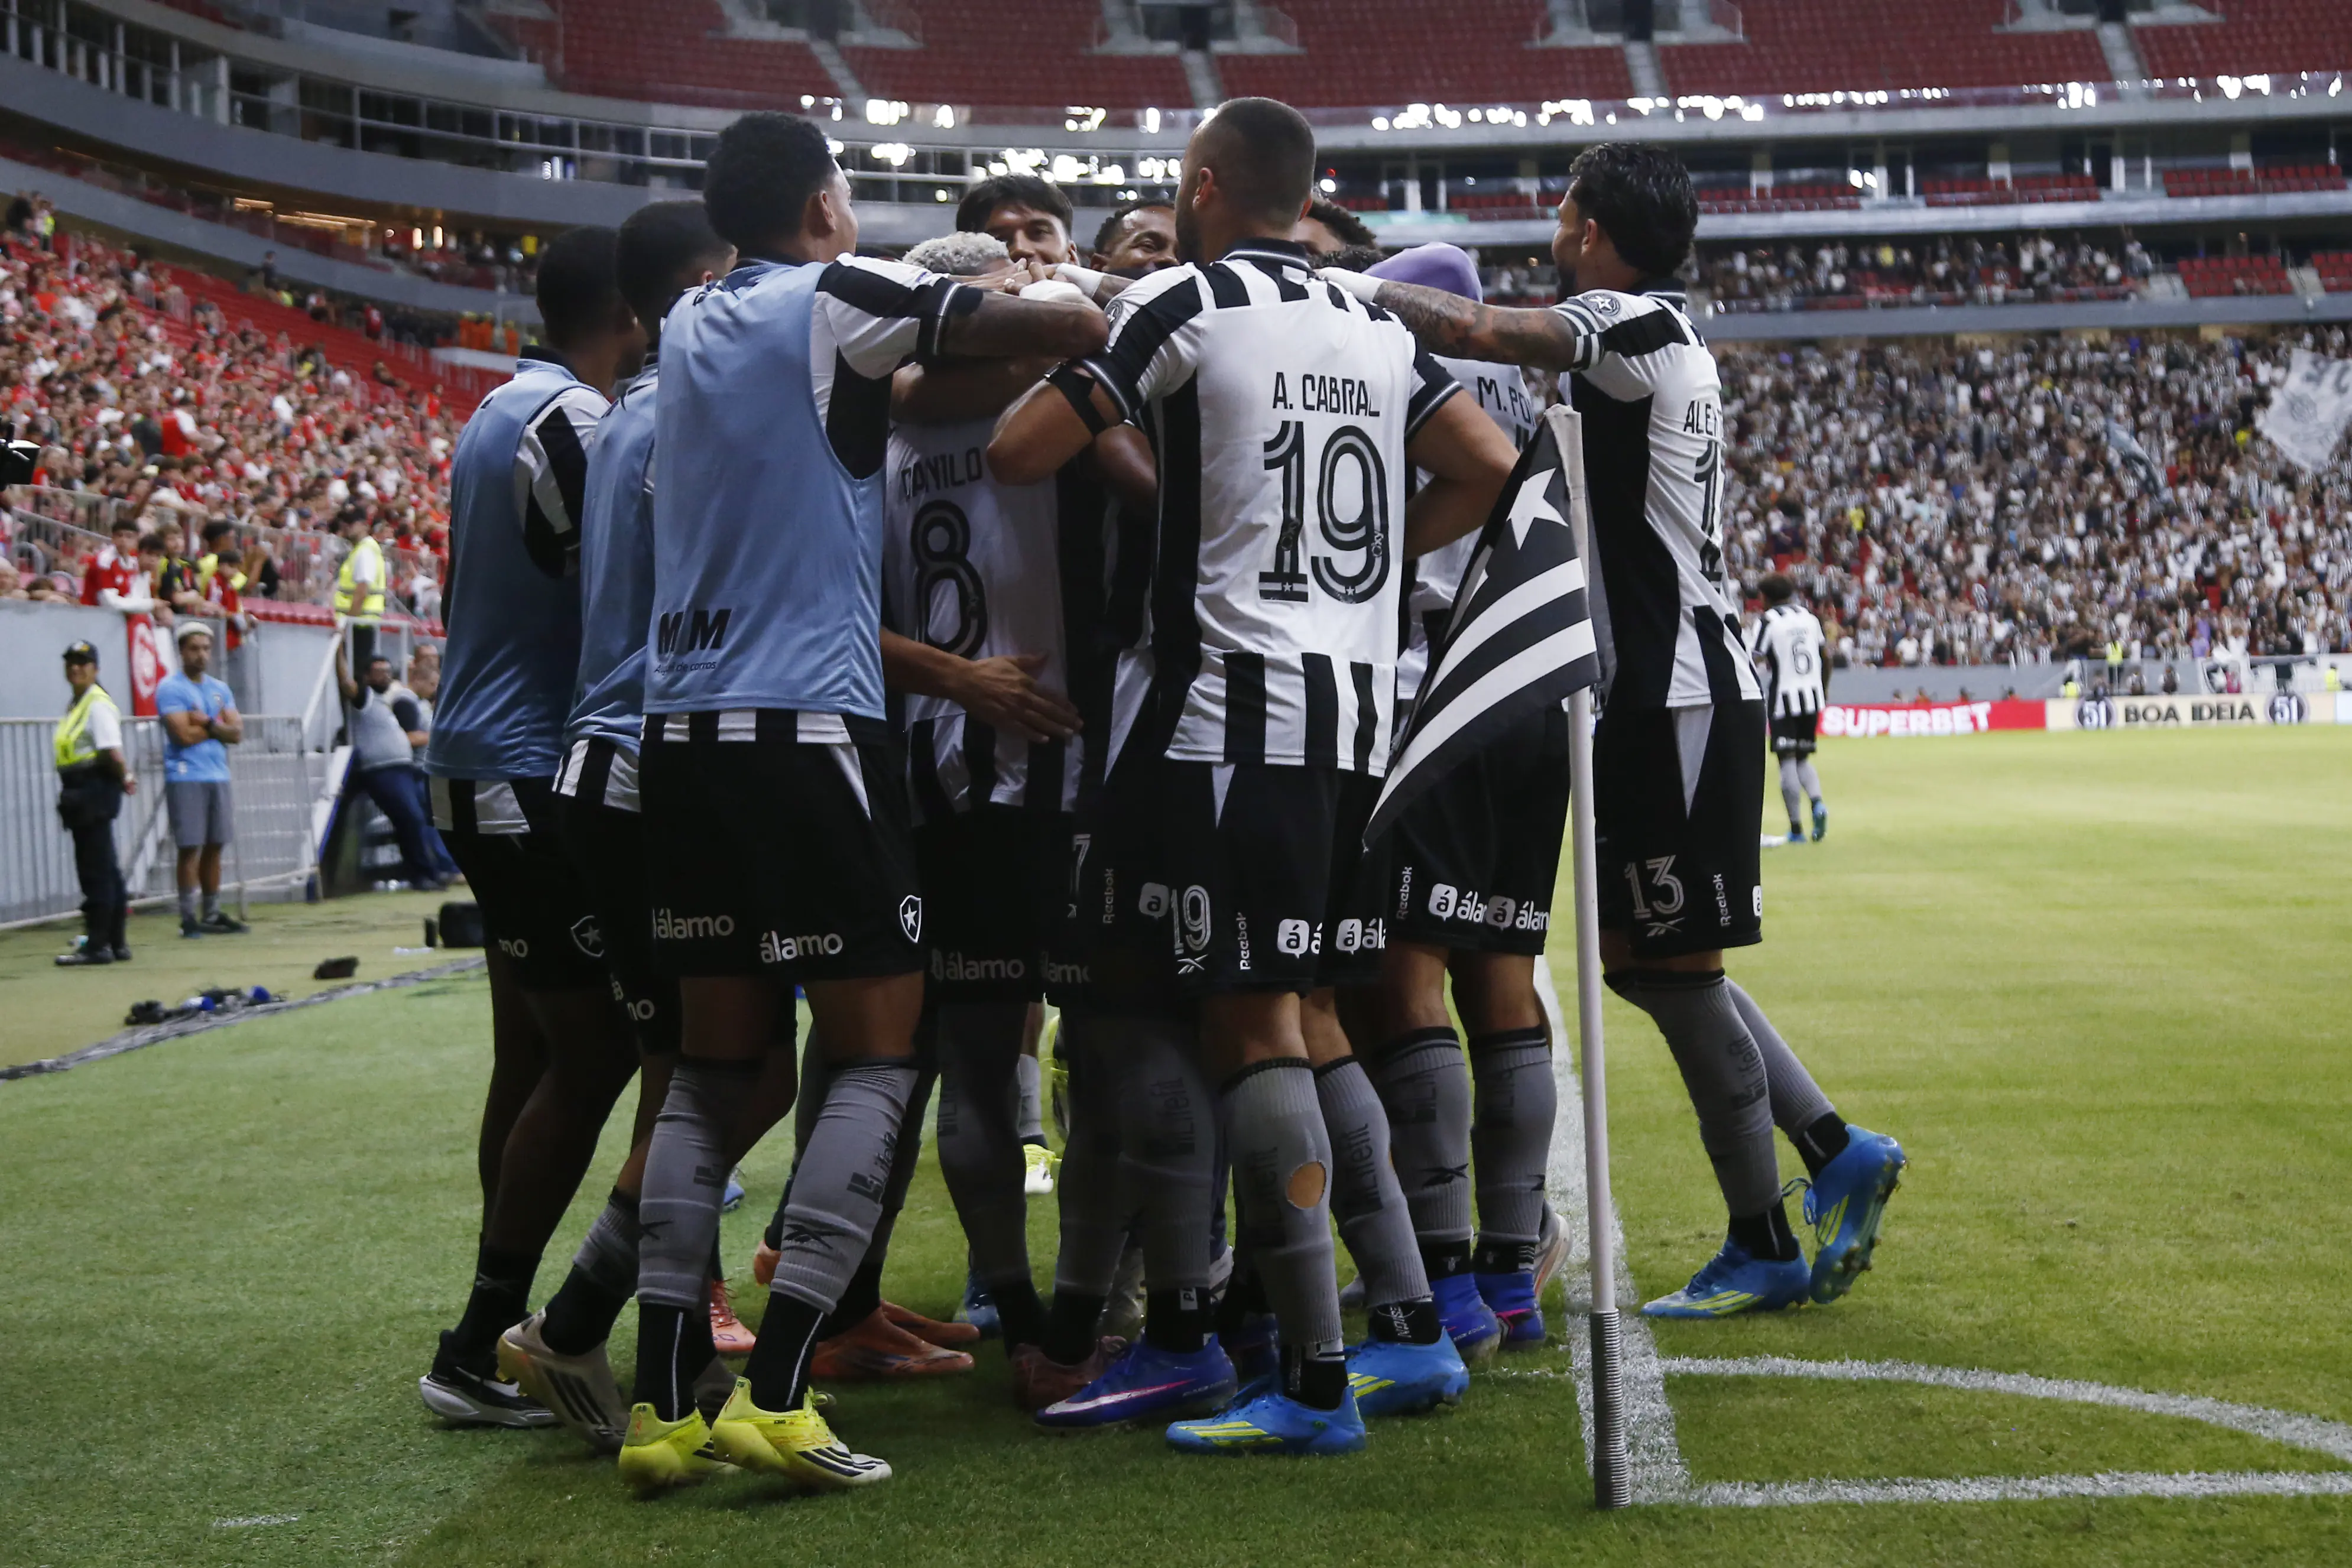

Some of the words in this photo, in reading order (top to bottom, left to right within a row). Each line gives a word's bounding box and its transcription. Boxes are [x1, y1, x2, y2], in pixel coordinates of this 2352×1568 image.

[1273, 372, 1293, 409] A.
[1302, 374, 1380, 417] CABRAL
[1477, 376, 1507, 412] M.
[1508, 386, 1535, 427] PO
[1683, 400, 1722, 434] ALE
[1258, 420, 1390, 605] 19
[911, 499, 988, 661] 8
[1792, 635, 1813, 674] 6
[1821, 702, 1991, 737] SUPERBET
[2083, 699, 2107, 730] 51
[2124, 704, 2181, 723] BOA
[2191, 701, 2256, 721] IDEIA
[2275, 696, 2298, 725] 51
[1103, 869, 1115, 924] Reebok
[1395, 866, 1412, 920] Reebok
[1624, 855, 1684, 919] 13
[1713, 873, 1731, 927] Reebok
[656, 908, 735, 939] álamo
[1170, 885, 1211, 955] 19
[1362, 918, 1387, 949] ál
[760, 931, 844, 963] álamo
[946, 951, 1025, 981] álamo
